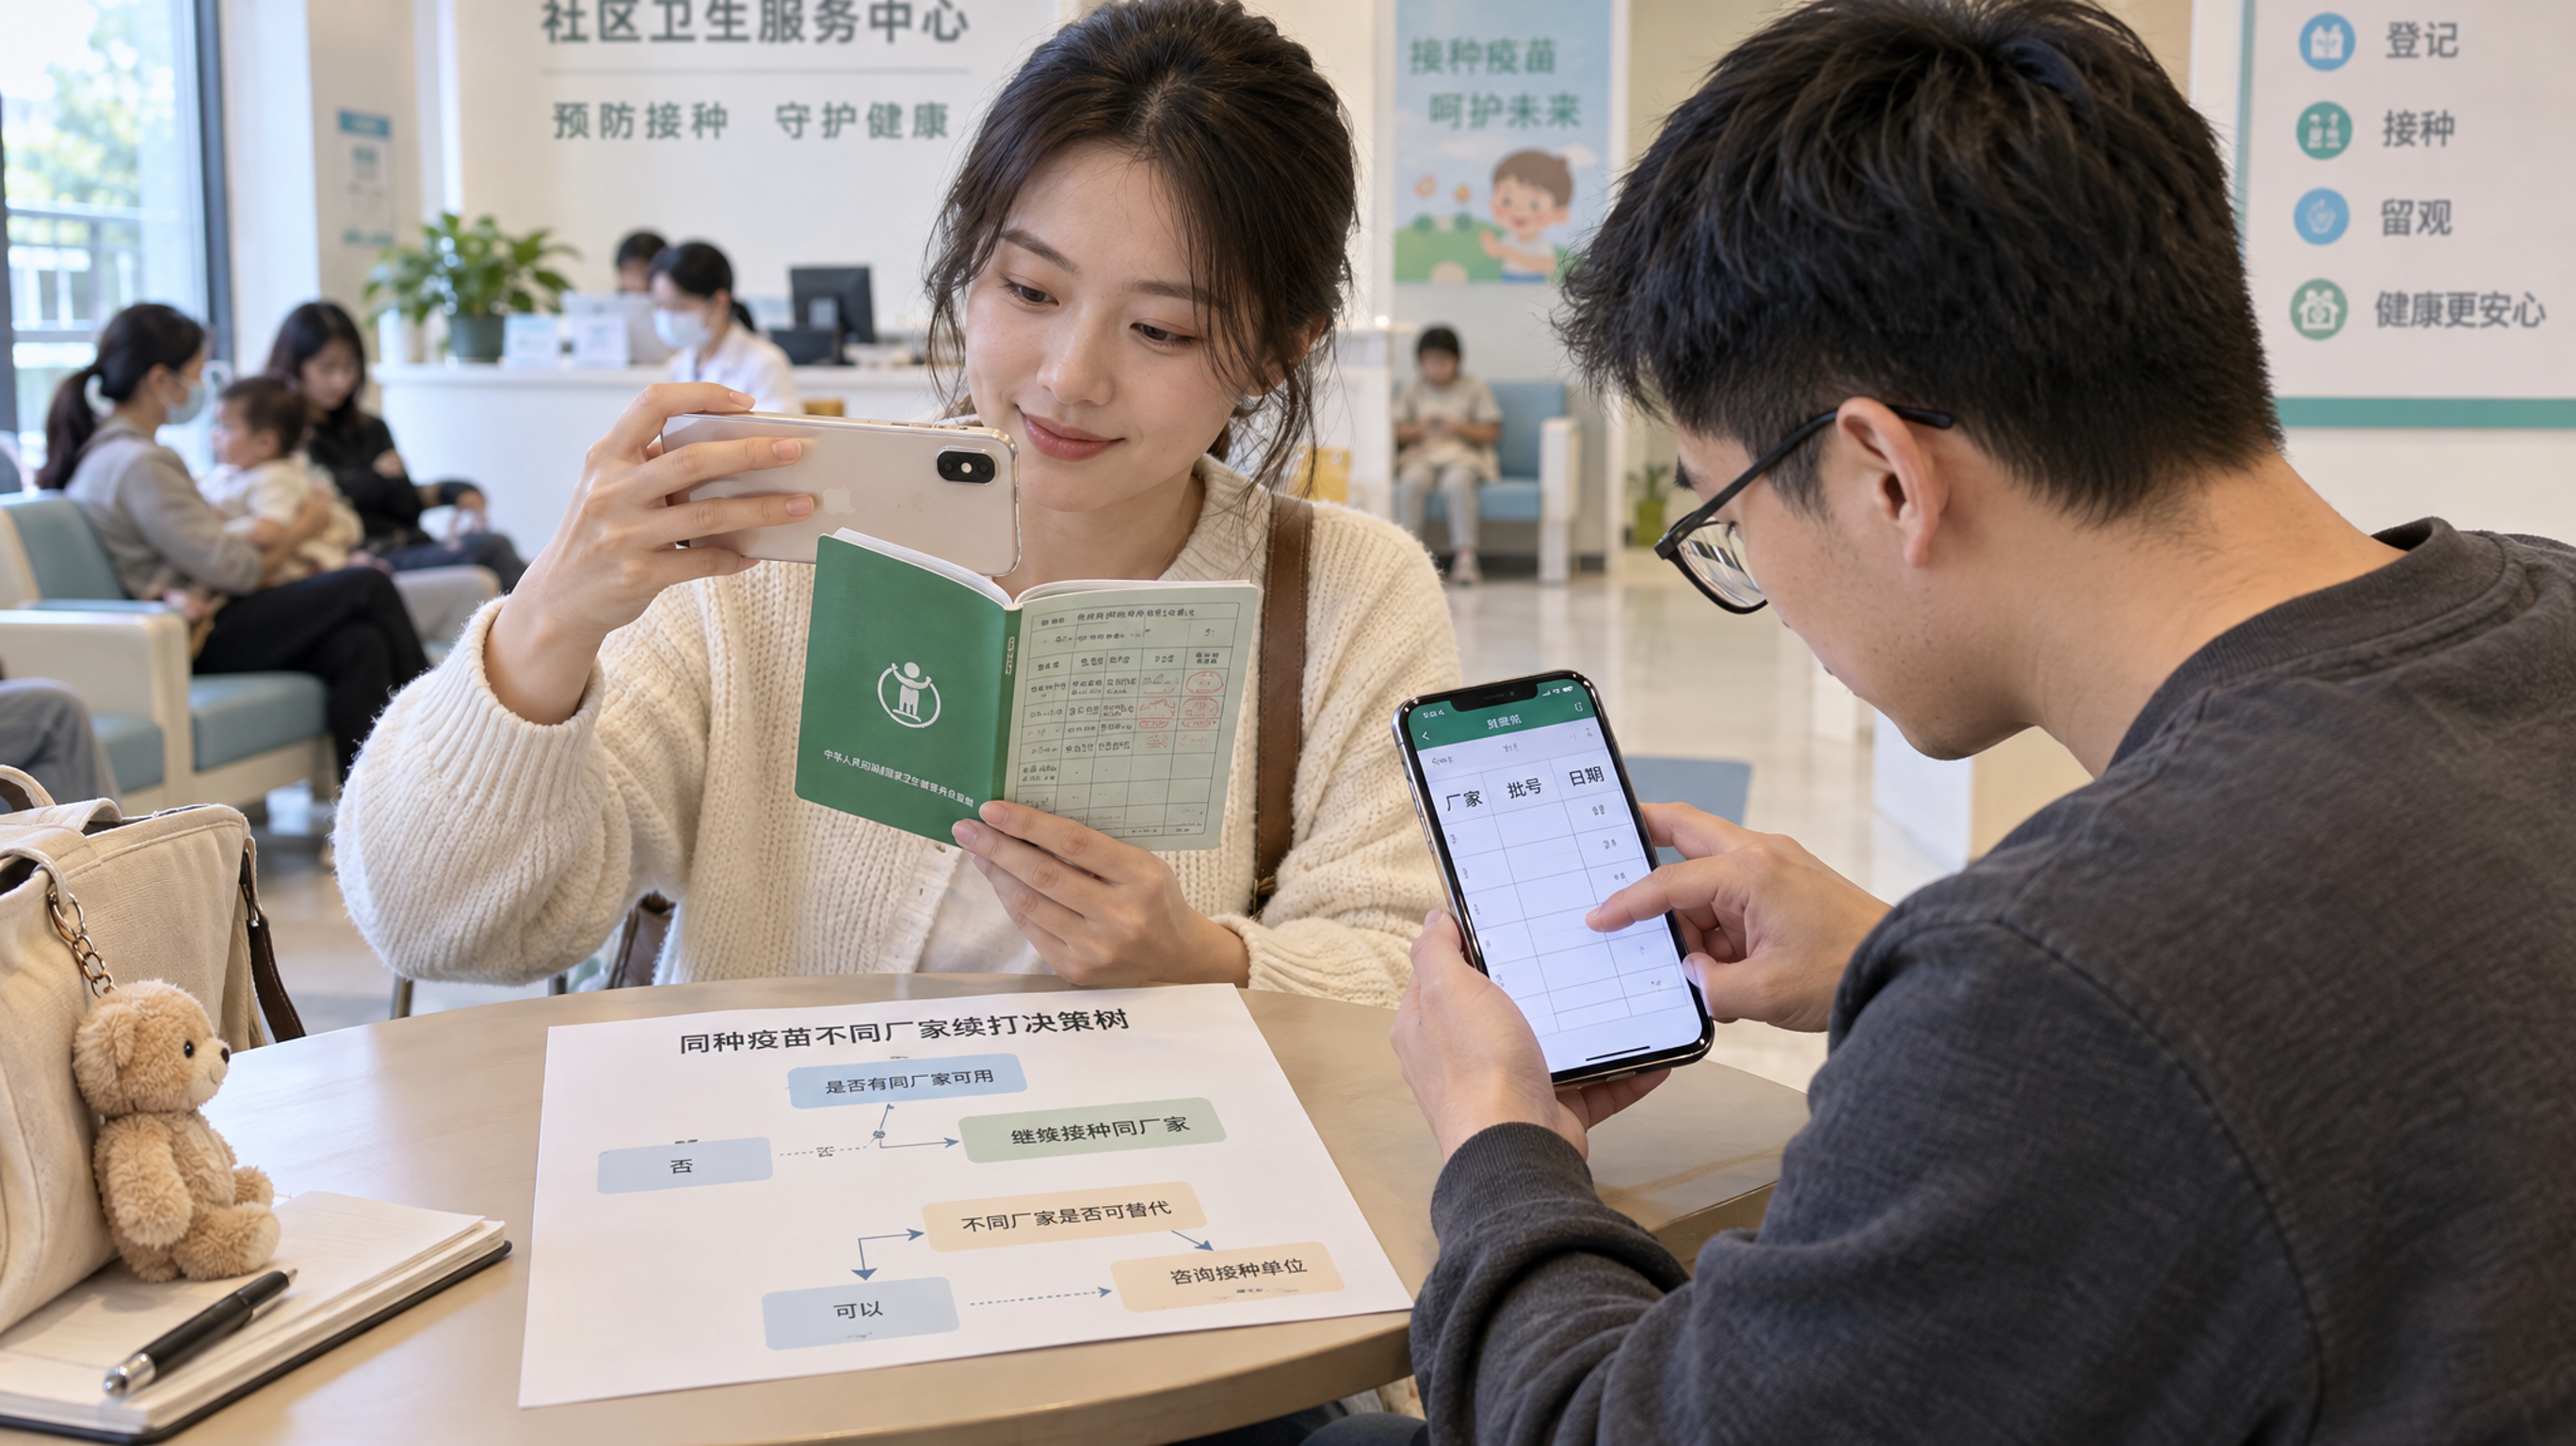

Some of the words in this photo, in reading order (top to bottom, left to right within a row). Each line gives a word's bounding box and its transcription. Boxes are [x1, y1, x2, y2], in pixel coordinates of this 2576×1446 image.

[541, 0, 969, 44] 社区卫生服务中心
[2385, 21, 2459, 59] 登记
[1409, 37, 1556, 74] 接种疫苗
[552, 102, 729, 140] 预防接种
[775, 102, 949, 140] 守护健康
[1429, 91, 1581, 130] 呵护未来
[2382, 109, 2455, 148] 接种
[2380, 199, 2453, 237] 留观
[2375, 290, 2547, 329] 健康更安心
[1445, 790, 1483, 811] 厂家
[1506, 778, 1542, 799] 批号
[1569, 765, 1605, 787] 日期
[679, 1008, 1130, 1055] 同种疫苗不同厂家续打决策树
[825, 1068, 995, 1095] 是否有同厂家可用
[669, 1158, 694, 1175] 否
[960, 1199, 1172, 1233] 不同厂家是否可替代
[1169, 1258, 1309, 1286] 咨询接种单位
[832, 1300, 884, 1320] 可以
